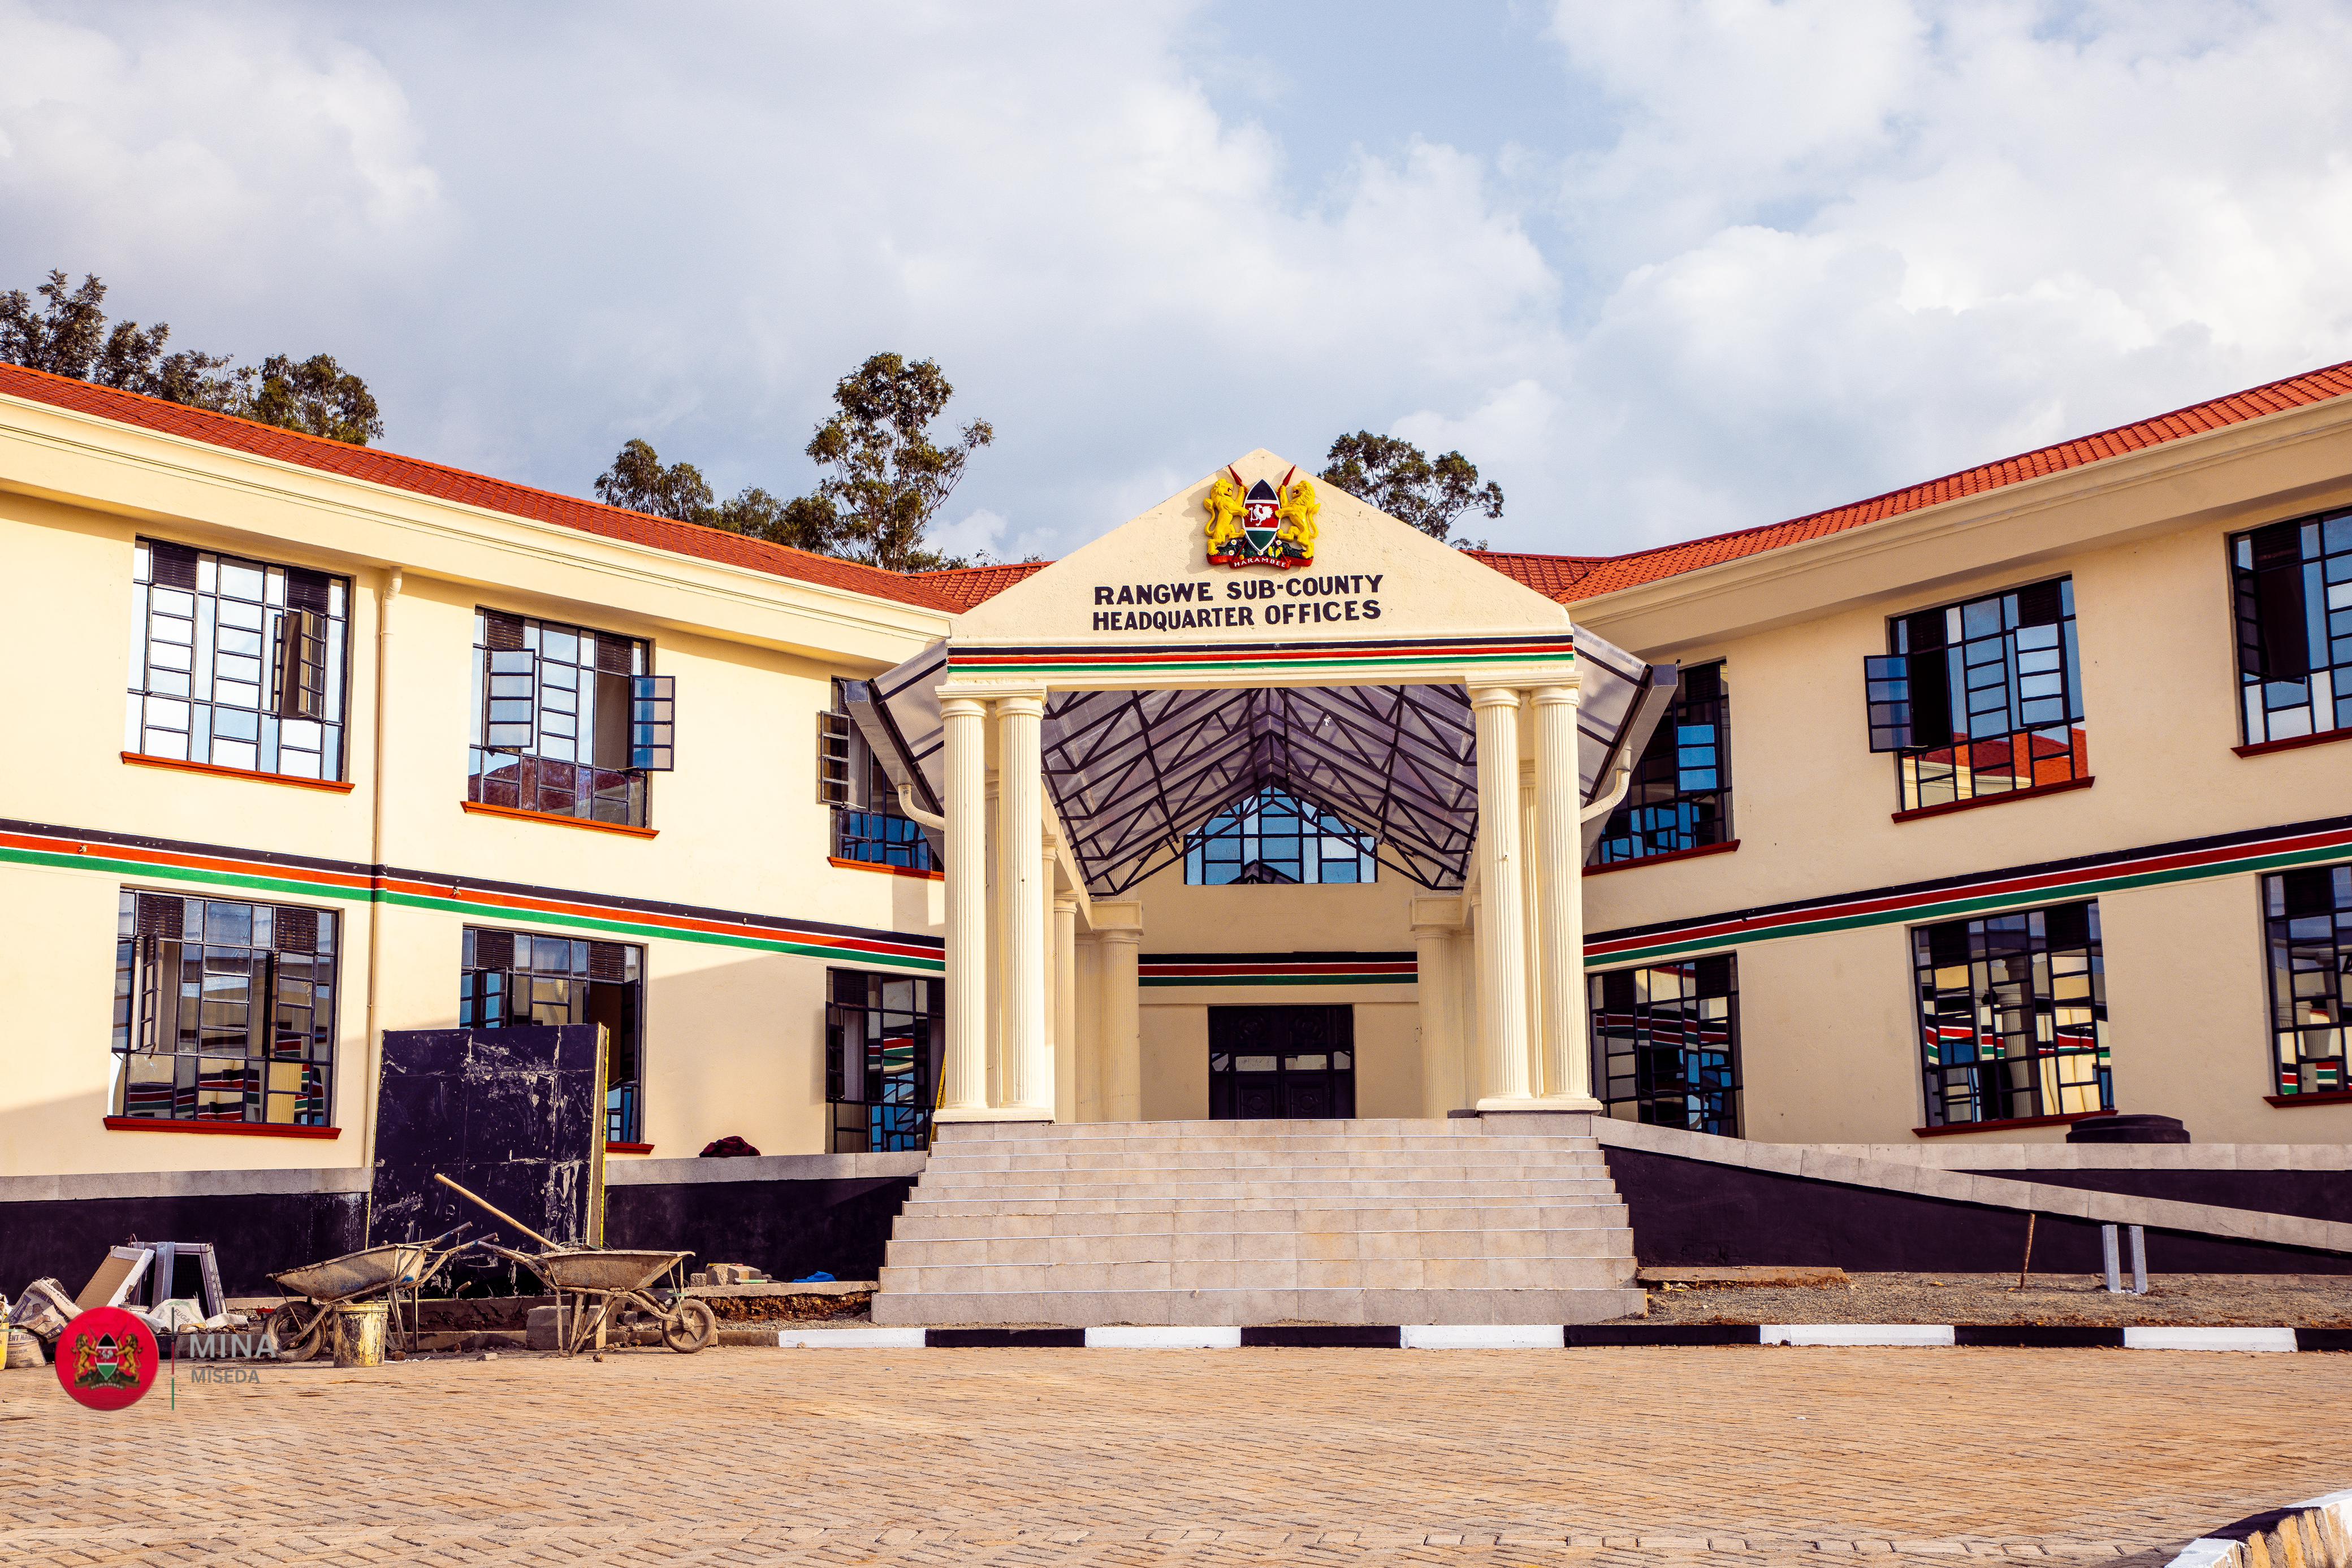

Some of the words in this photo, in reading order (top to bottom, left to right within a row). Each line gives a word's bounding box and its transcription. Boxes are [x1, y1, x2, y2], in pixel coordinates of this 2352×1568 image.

[1234, 557, 1286, 568] HARAMBEE
[1095, 582, 1213, 605] RANGWE
[1226, 574, 1383, 600] SUB-COUNTY
[1093, 607, 1255, 632] HEADQUARTER
[1265, 599, 1381, 625] OFFICES
